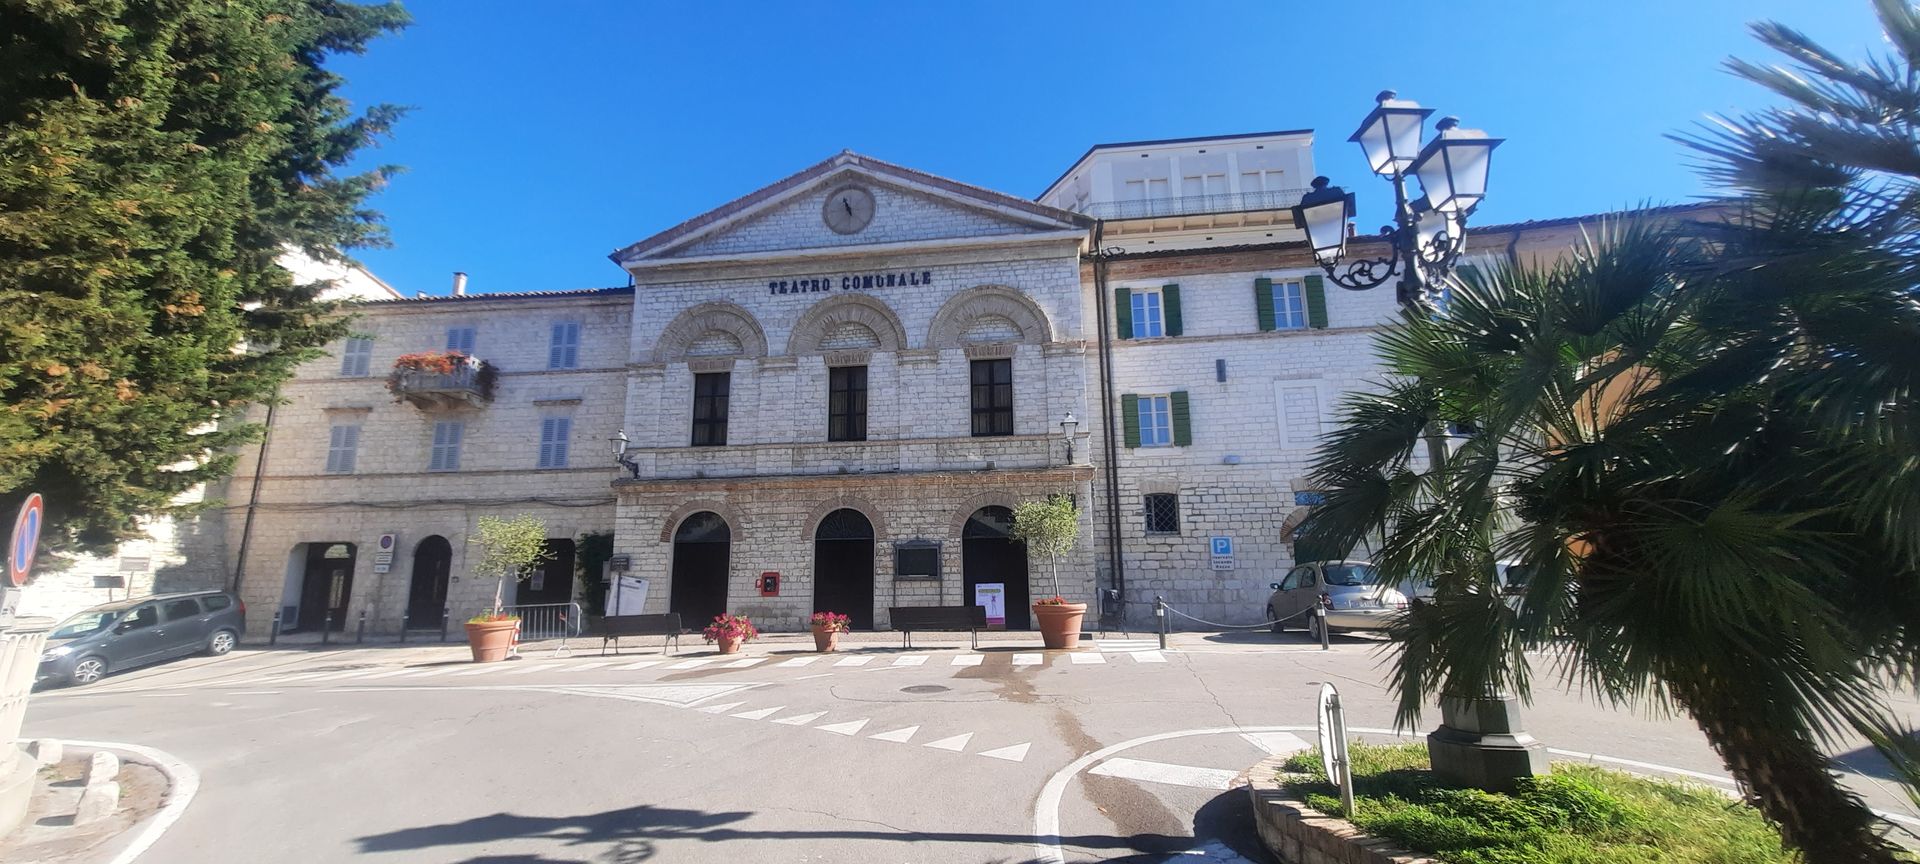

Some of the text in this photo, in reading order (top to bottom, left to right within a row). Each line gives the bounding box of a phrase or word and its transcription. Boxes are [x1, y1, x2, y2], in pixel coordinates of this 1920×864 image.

[769, 272, 931, 294] TEATRO COMUNALE
[1216, 540, 1228, 552] P
